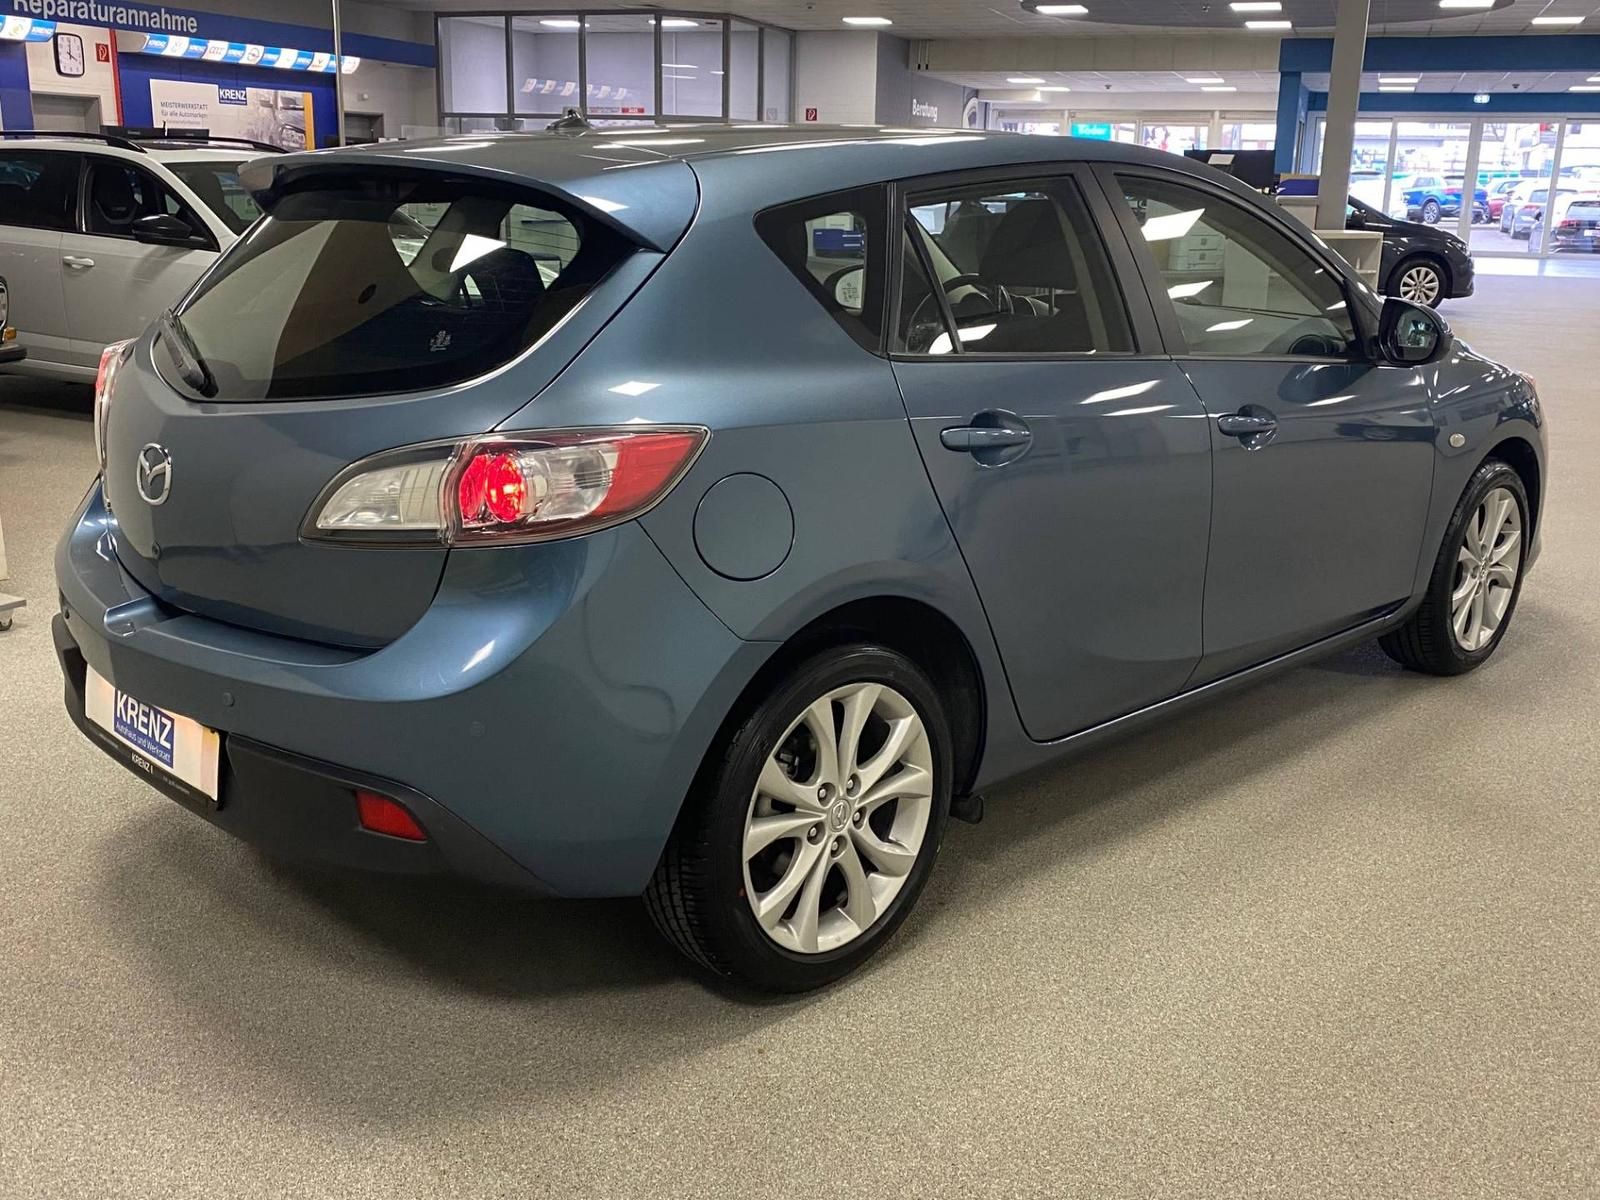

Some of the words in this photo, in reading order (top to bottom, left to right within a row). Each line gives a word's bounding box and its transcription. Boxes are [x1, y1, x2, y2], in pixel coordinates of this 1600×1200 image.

[219, 88, 247, 100] KRENZ
[160, 101, 208, 111] MEISTERWERKSTATT
[179, 111, 208, 119] Automarken
[912, 98, 938, 123] Beratung
[116, 689, 172, 750] KRENZ
[115, 721, 137, 742] Autohaus
[137, 736, 147, 748] und
[147, 740, 171, 762] Werkstatt
[131, 751, 150, 773] KRENZ
